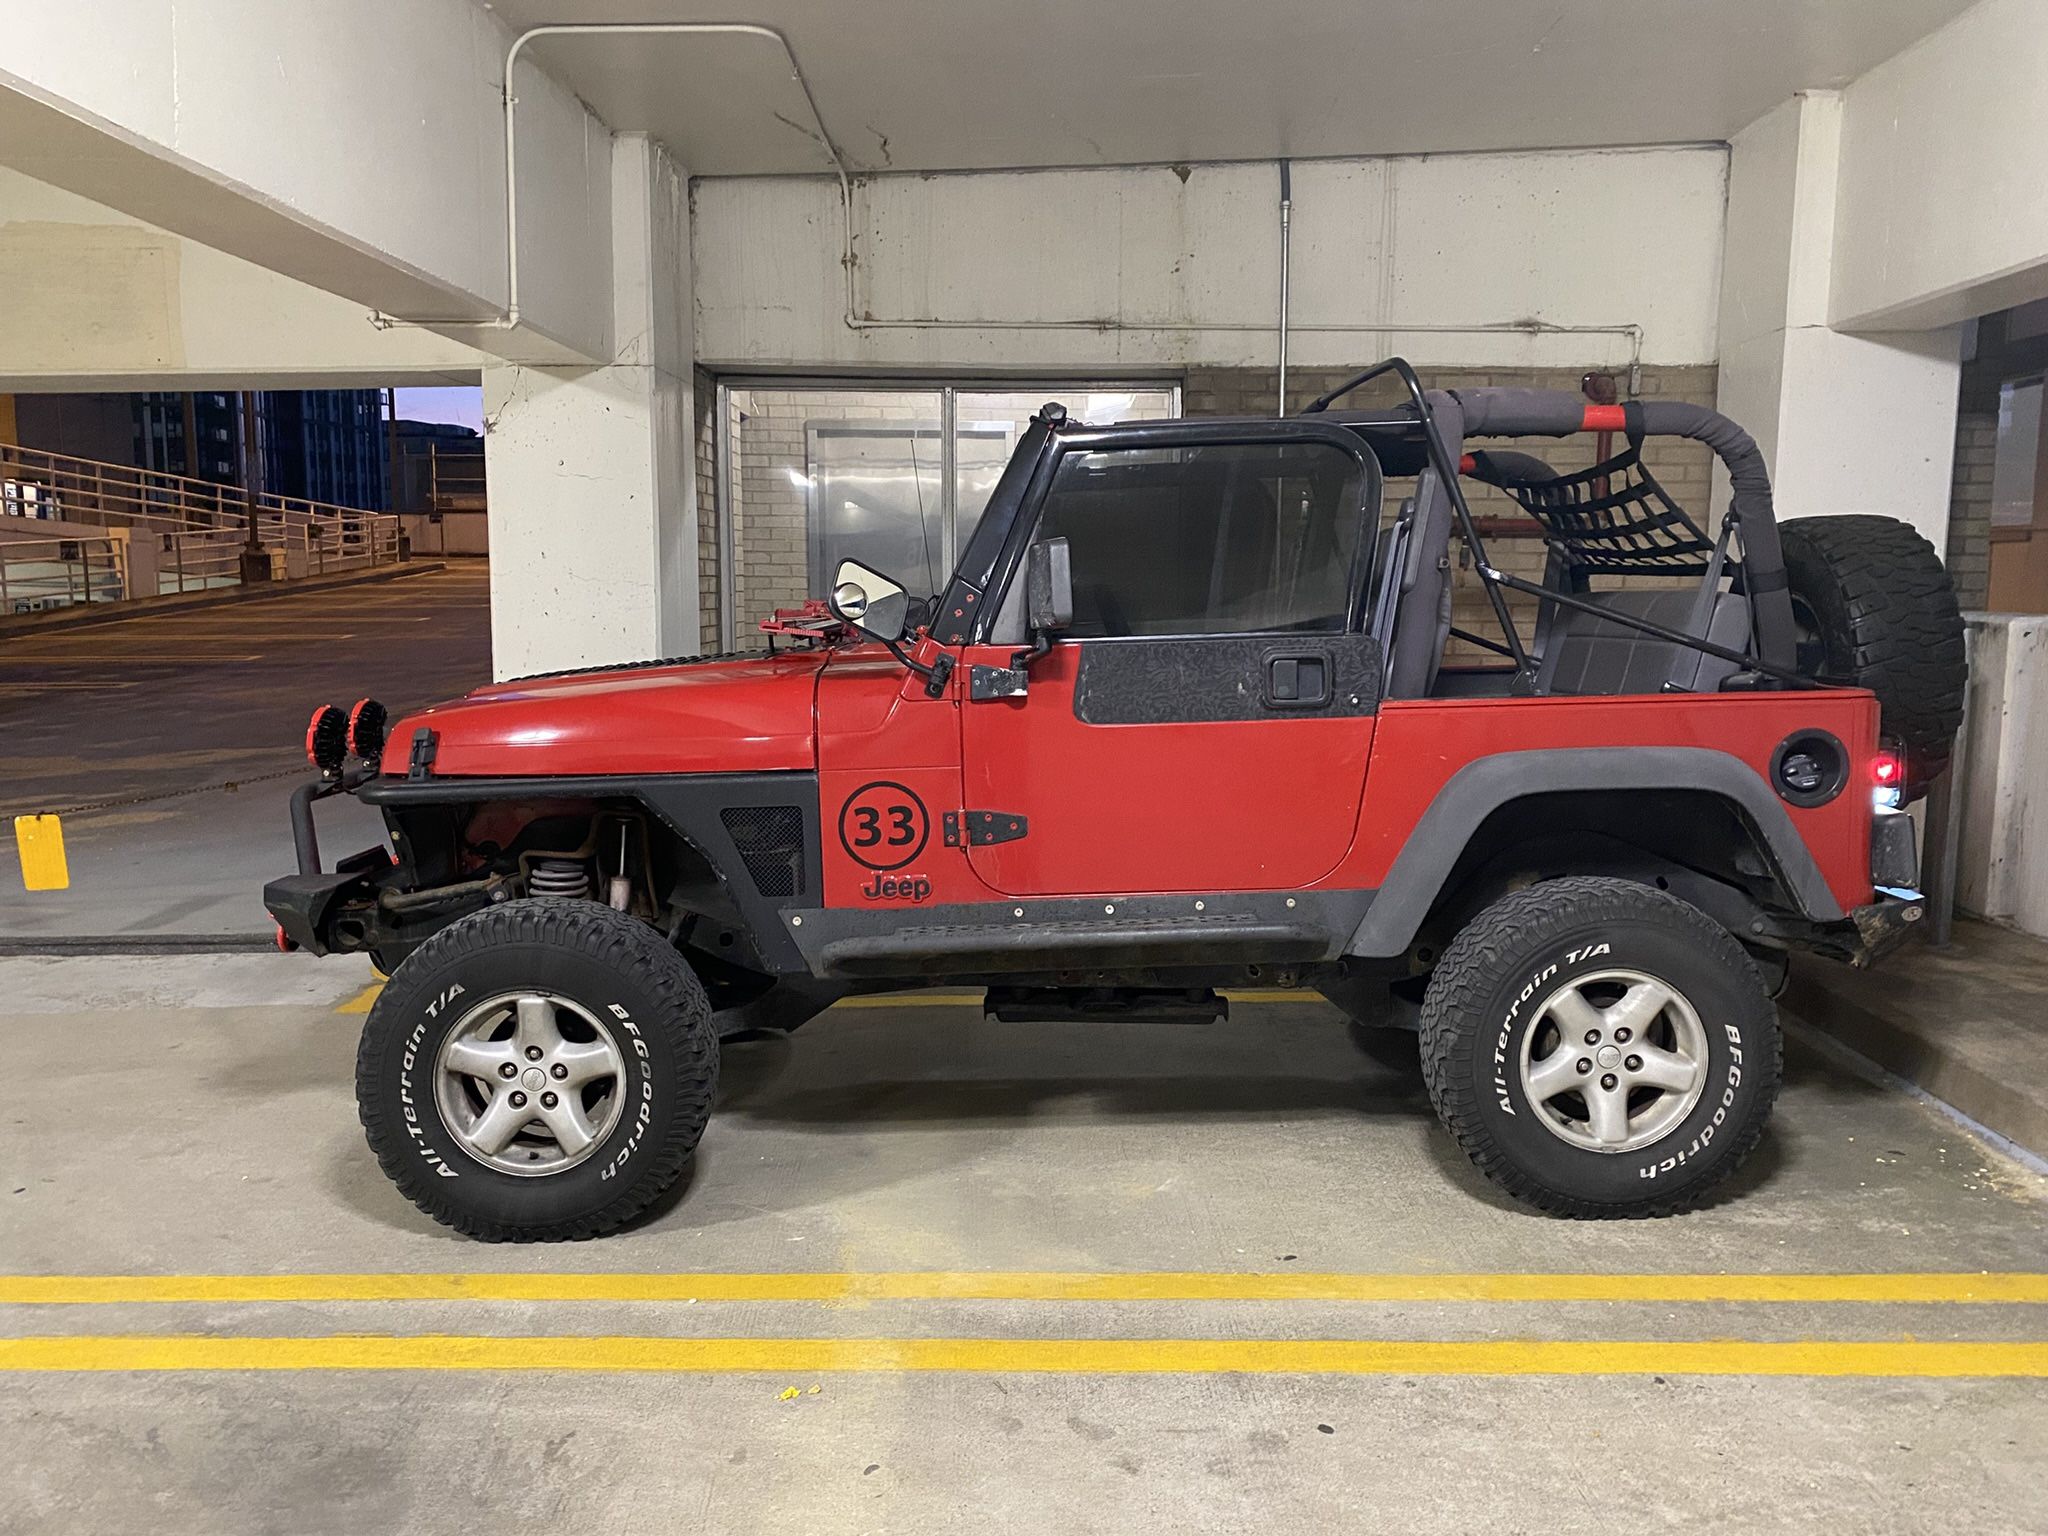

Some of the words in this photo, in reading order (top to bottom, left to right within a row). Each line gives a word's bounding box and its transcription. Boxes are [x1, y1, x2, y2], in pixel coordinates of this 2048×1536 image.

[854, 805, 915, 847] 33
[862, 873, 931, 902] Jeep
[1565, 942, 1612, 965] T/A
[425, 982, 467, 1019] T/A
[601, 1003, 653, 1182] BFGoodrich
[1639, 1024, 1743, 1180] BFGoodrich
